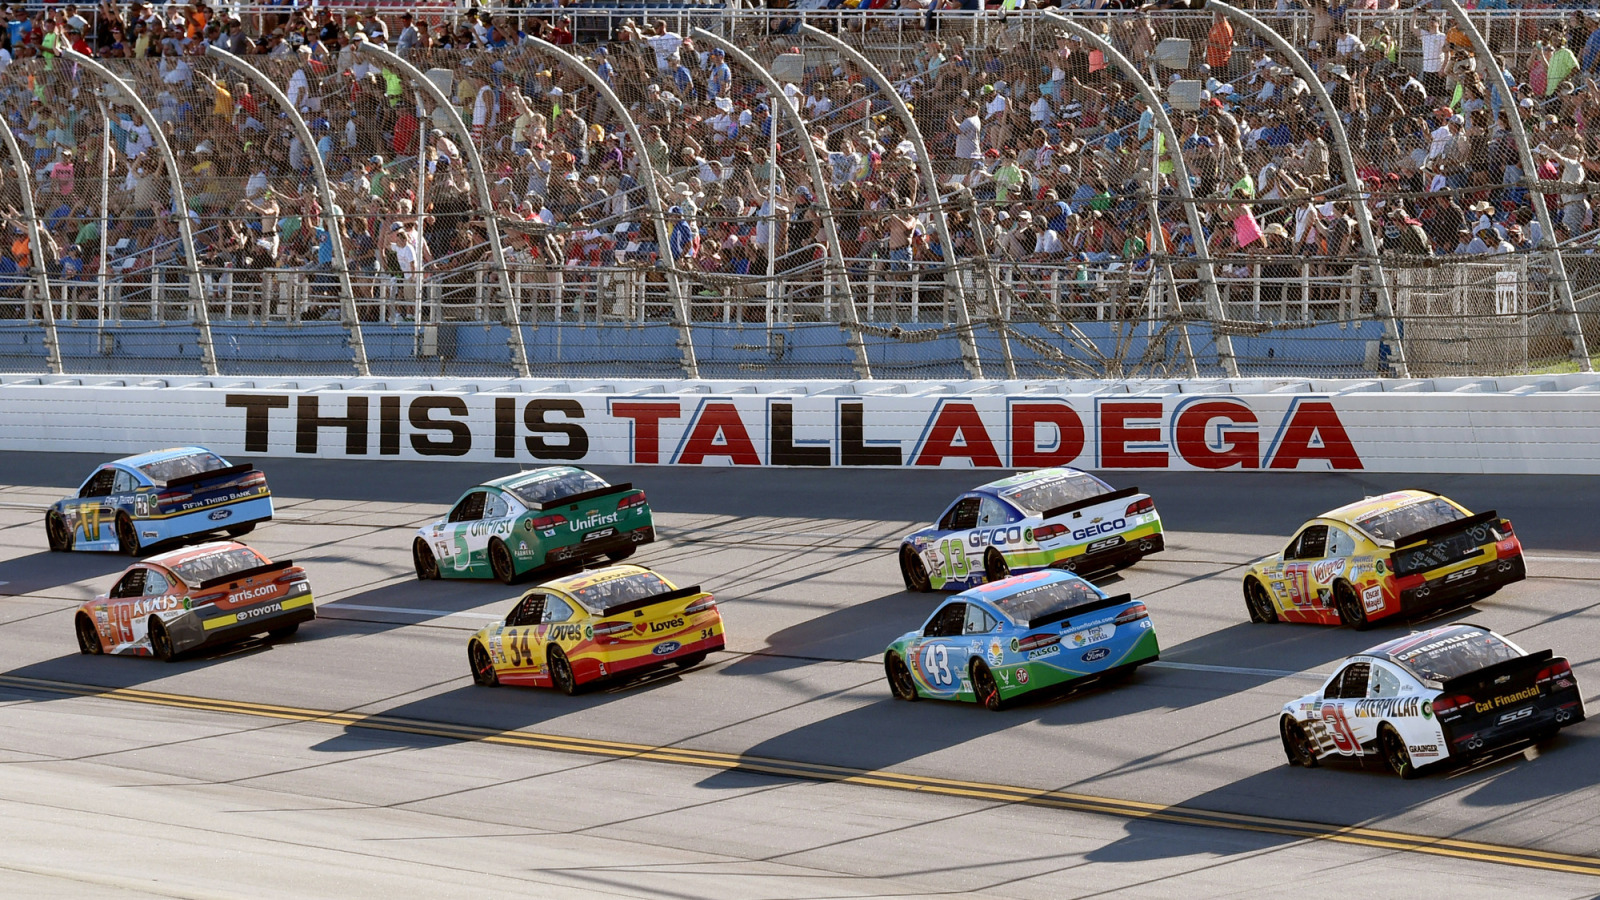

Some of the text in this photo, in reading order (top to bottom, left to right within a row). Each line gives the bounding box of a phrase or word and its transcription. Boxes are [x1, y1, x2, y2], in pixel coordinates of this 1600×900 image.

[225, 395, 1364, 470] THIS IS TALLADEGA
[229, 490, 251, 500] BANK
[212, 511, 229, 519] Ford
[636, 507, 643, 515] 5
[1142, 513, 1154, 522] 13
[80, 502, 100, 541] 17
[471, 519, 512, 537] UniFirst
[569, 511, 618, 532] UniFirst
[1073, 518, 1126, 541] GEICO
[969, 526, 1021, 547] GEICO
[454, 524, 471, 571] 5
[940, 539, 970, 582] 13
[1314, 559, 1346, 581] Velveeta
[297, 583, 307, 592] 19
[1017, 583, 1058, 598] ALMIROLA
[1285, 562, 1313, 606] 37
[229, 583, 278, 604] arris.com
[1365, 589, 1380, 600] Oscar
[134, 595, 178, 616] ARRIS
[247, 603, 282, 618] TOYOTA
[1366, 598, 1383, 610] Mayer
[113, 602, 135, 642] 19
[1139, 621, 1151, 629] 43
[701, 628, 714, 639] 34
[1088, 633, 1108, 644] Florida
[508, 628, 535, 667] 34
[657, 643, 675, 654] Ford
[1029, 645, 1059, 659] ALSCO
[1397, 631, 1484, 661] CATERPILLAR
[1428, 641, 1469, 657] NEWMAN
[925, 644, 953, 685] 43
[1086, 650, 1107, 661] Ford
[1017, 669, 1027, 682] STP
[1354, 697, 1420, 718] CATERPILLAR
[1475, 684, 1541, 714] Cat Financial
[1321, 703, 1364, 756] 31
[1409, 745, 1438, 753] GRAINGER
